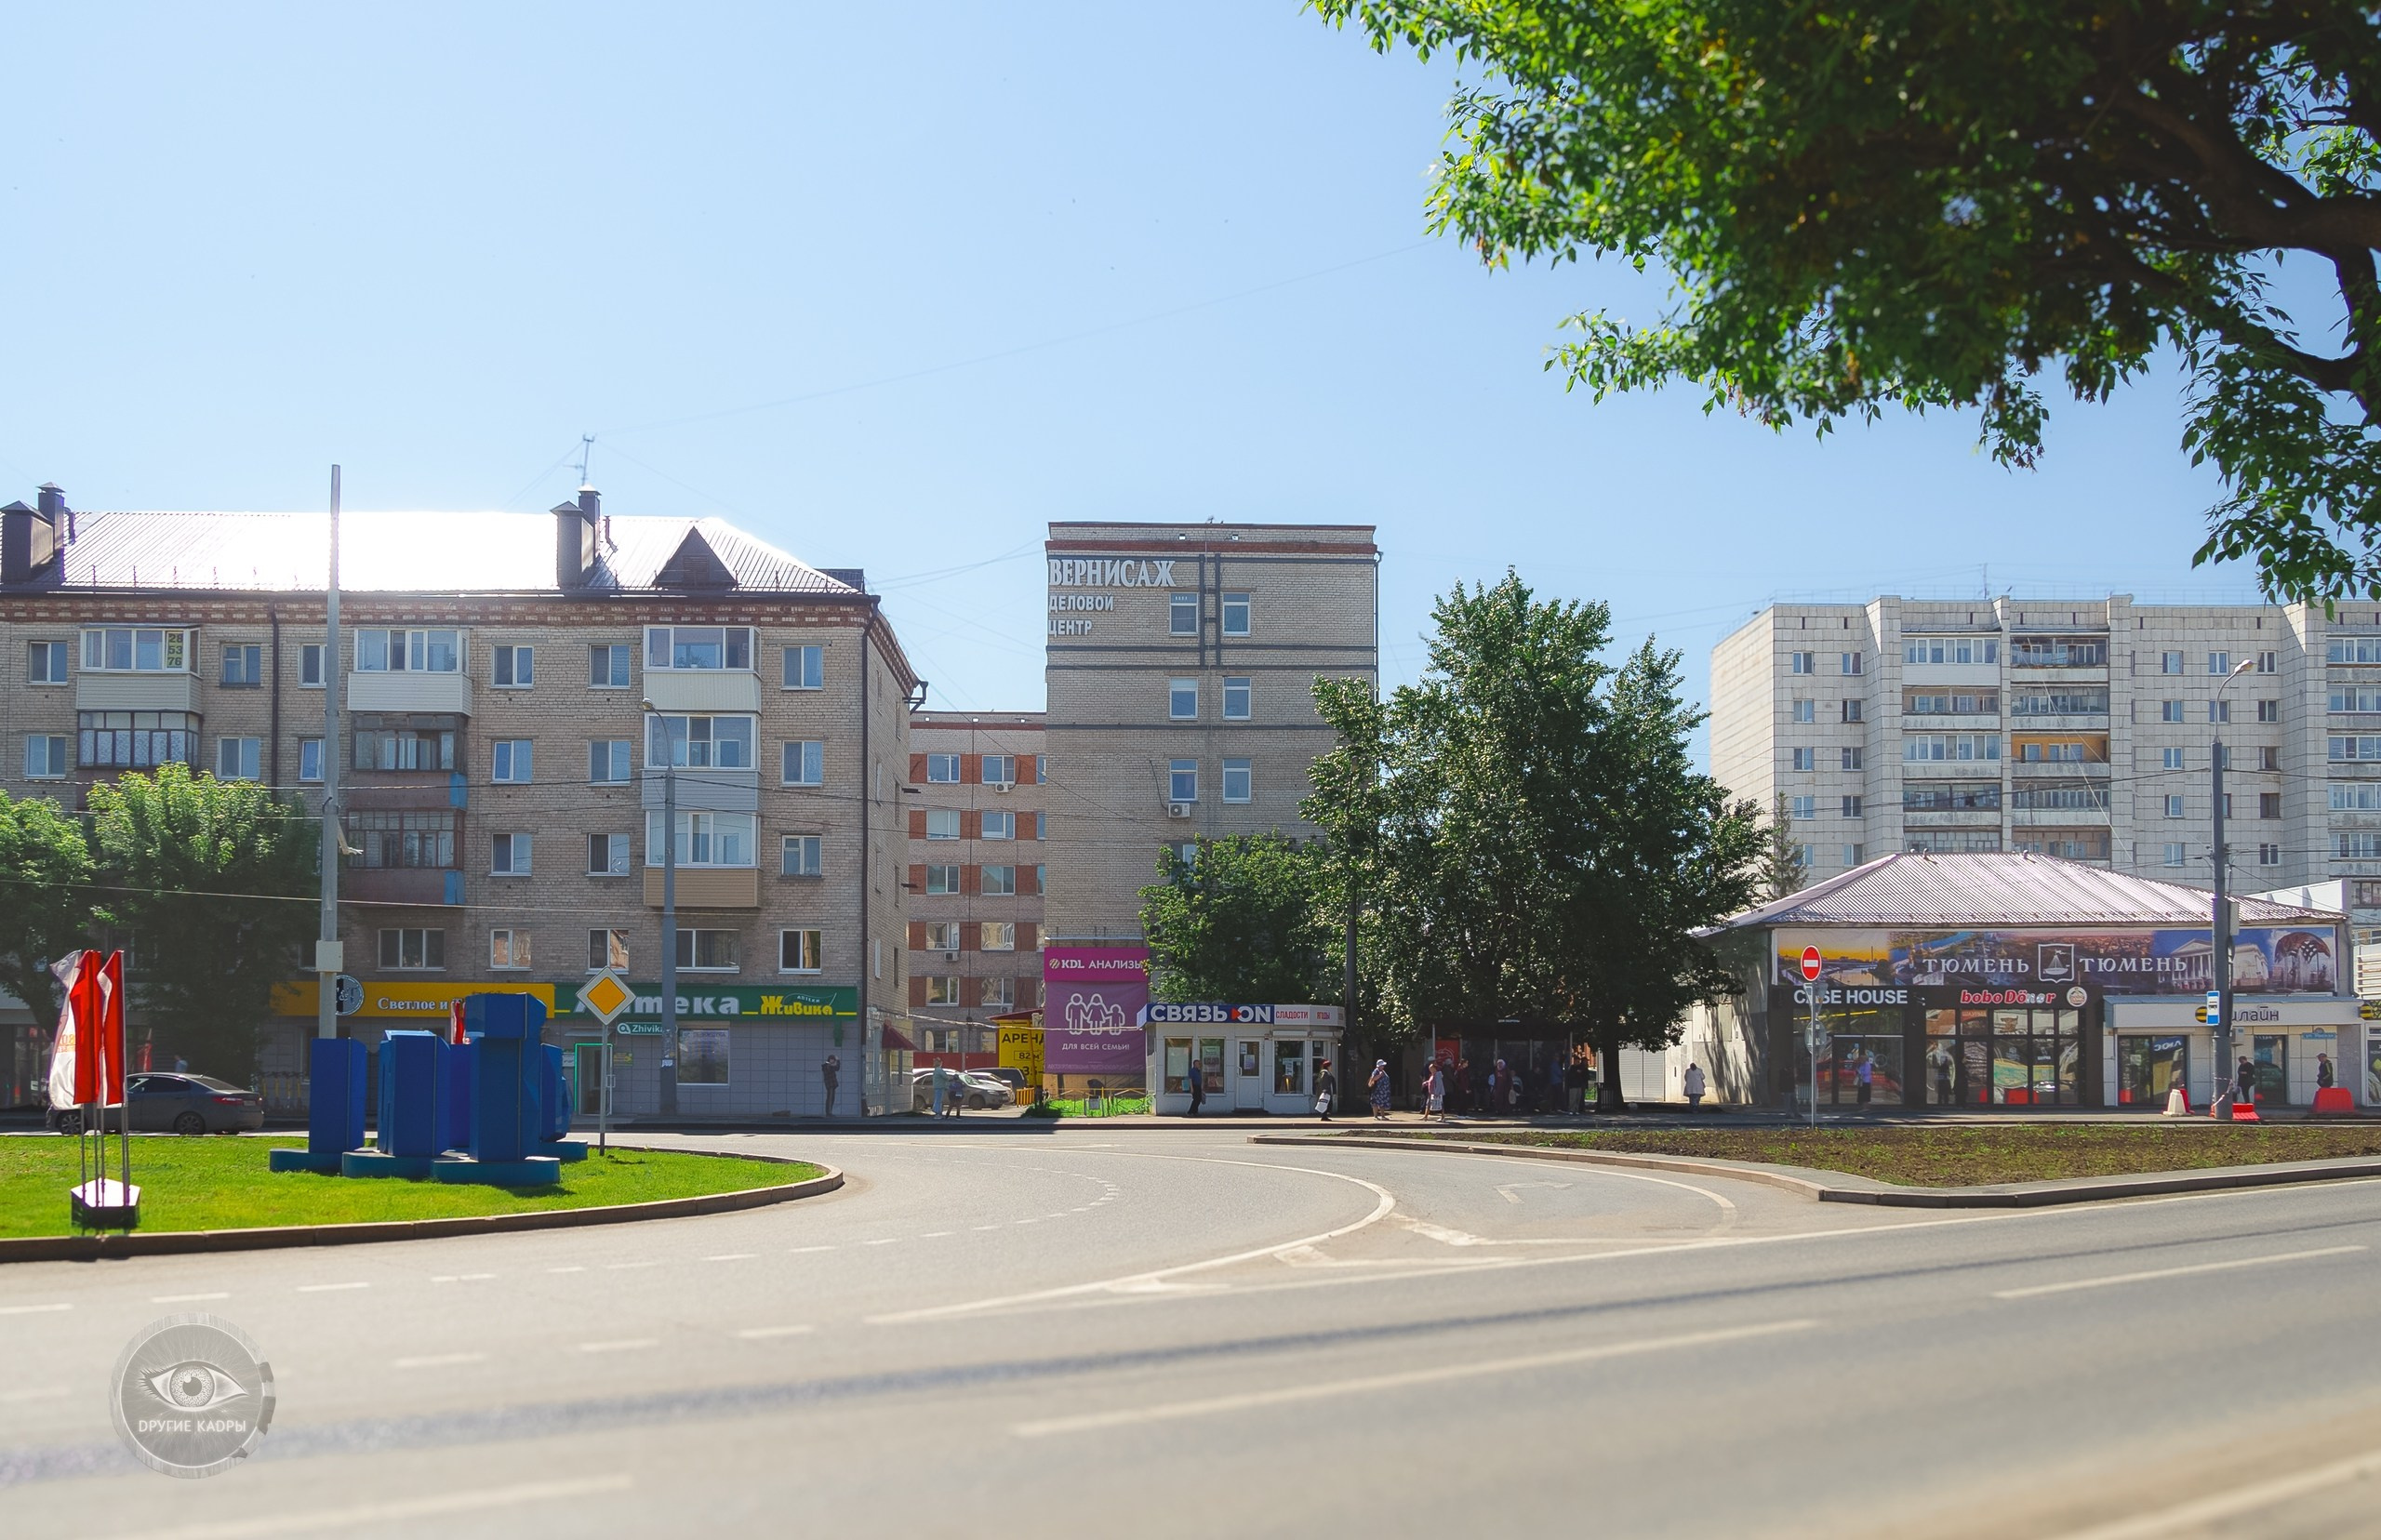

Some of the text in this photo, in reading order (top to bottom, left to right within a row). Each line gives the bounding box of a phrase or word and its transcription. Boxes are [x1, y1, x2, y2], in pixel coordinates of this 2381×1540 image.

[1048, 559, 1177, 588] ВЕРНИСАЖ
[1048, 592, 1114, 611] ДЕЛОВОЙ
[1048, 619, 1093, 638] ЦЕНТР
[168, 633, 183, 643] 28
[167, 645, 183, 655] 53
[167, 657, 182, 666] 76
[1061, 959, 1085, 969] KDL
[1922, 958, 2029, 974] ТЮМЕНЬ
[2079, 957, 2188, 973] ТЮМЕНЬ
[377, 997, 436, 1010] Светлое
[439, 1000, 448, 1010] и
[1793, 989, 1909, 1004] CSE HOUSE
[1960, 989, 2056, 1004] bobo Döner
[573, 995, 740, 1016] тека
[761, 995, 833, 1016] Живика
[2231, 1005, 2280, 1021] илайн
[1150, 1004, 1271, 1023] СВЯЗЬ ON
[1275, 1011, 1309, 1019] СЛАДОСТИ
[1002, 1032, 1044, 1045] АРЕН
[1061, 1042, 1078, 1051] ДЛЯ
[1101, 1042, 1130, 1051] СЕМЬИ!
[1018, 1052, 1031, 1060] 82
